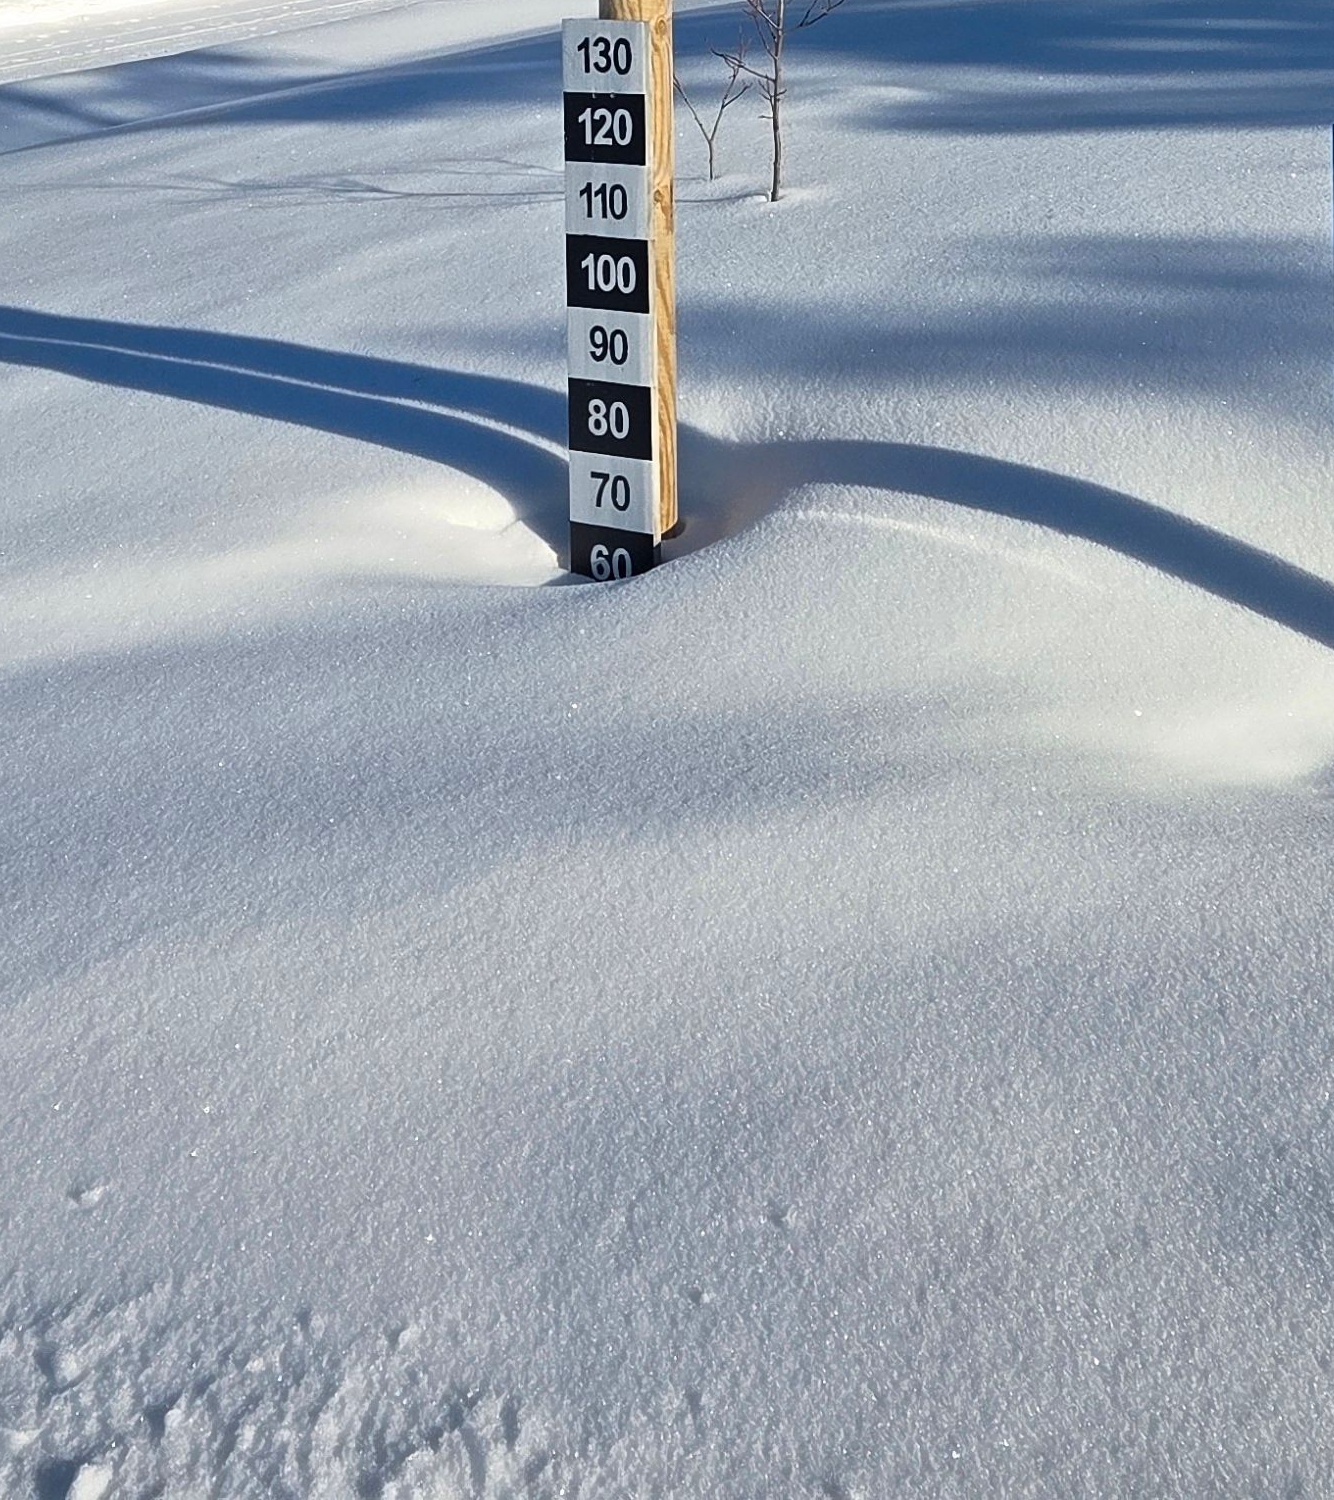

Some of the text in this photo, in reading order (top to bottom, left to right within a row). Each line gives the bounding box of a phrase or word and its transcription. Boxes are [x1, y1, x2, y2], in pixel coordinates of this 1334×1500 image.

[577, 37, 632, 75] 130
[578, 108, 633, 146] 120
[579, 182, 628, 220] 110
[581, 253, 636, 294] 100
[589, 325, 629, 365] 90
[588, 399, 630, 439] 80
[590, 471, 630, 511] 70
[590, 544, 632, 581] 60
